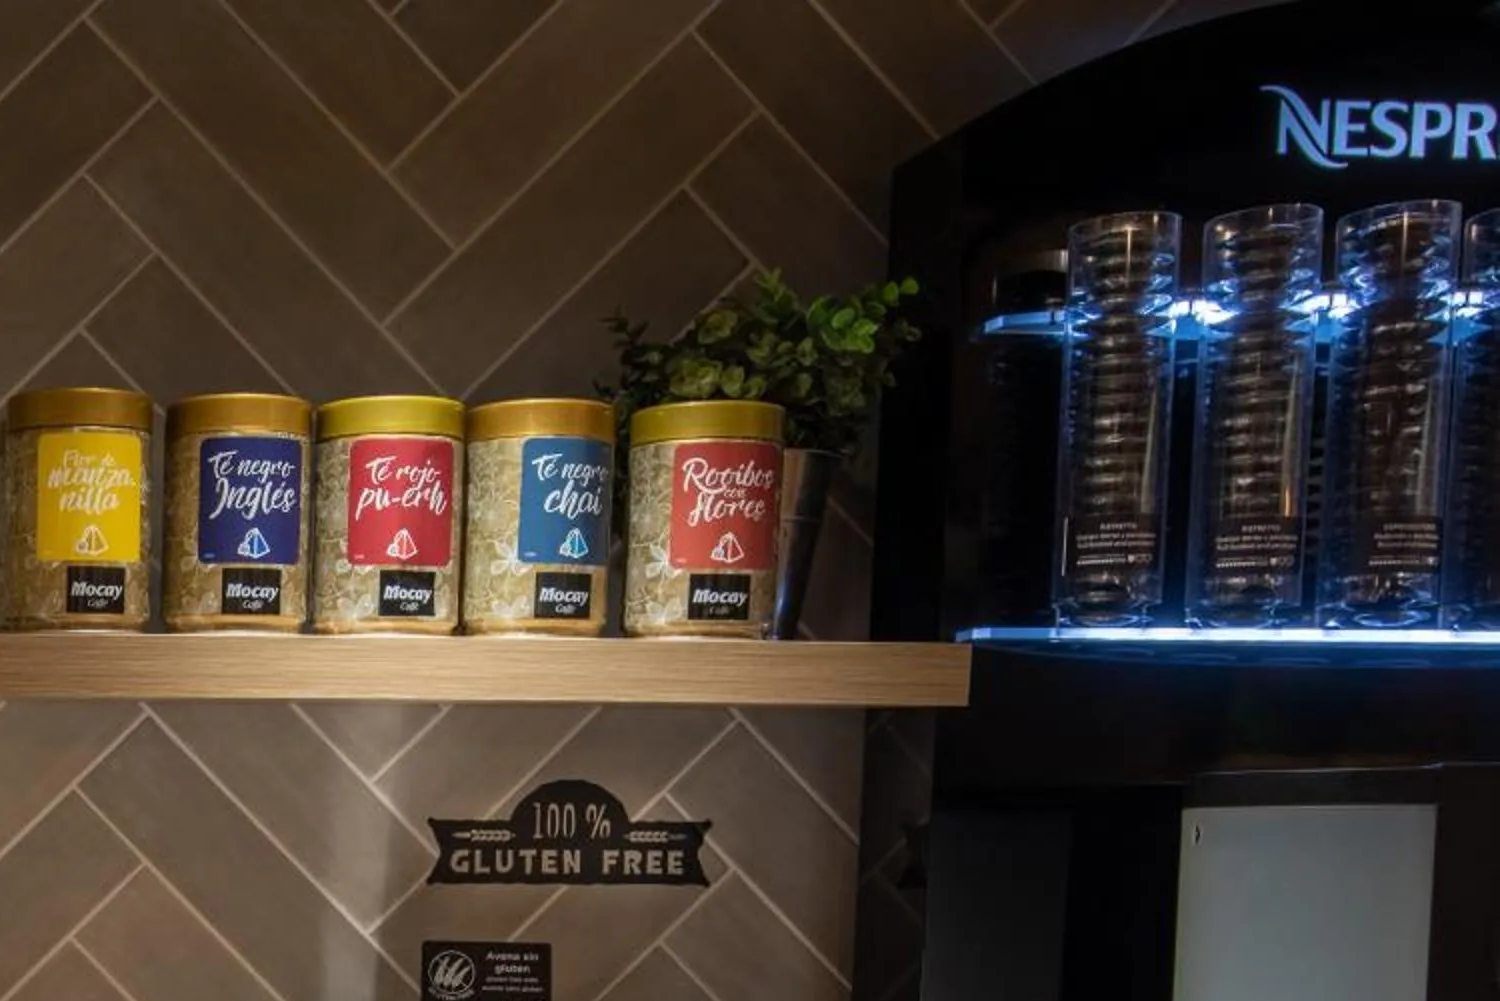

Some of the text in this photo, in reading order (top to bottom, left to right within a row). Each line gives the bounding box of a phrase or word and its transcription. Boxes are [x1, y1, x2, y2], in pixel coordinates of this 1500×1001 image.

[1260, 84, 1500, 168] NESPR
[207, 450, 296, 484] Té negro
[365, 455, 441, 490] Té rojo
[532, 453, 563, 481] Té
[682, 457, 774, 493] Rooibos
[209, 477, 296, 520] Inglés
[355, 479, 447, 521] pu-erh
[544, 479, 603, 520] chai
[71, 581, 123, 600] Mocay
[226, 583, 279, 602] Mocay
[384, 584, 433, 604] Mocay
[539, 586, 588, 606] Mocay
[692, 588, 747, 606] Mocay
[532, 802, 576, 839] 100
[449, 848, 685, 875] GLUTEN FREE
[494, 964, 531, 975] gluten
